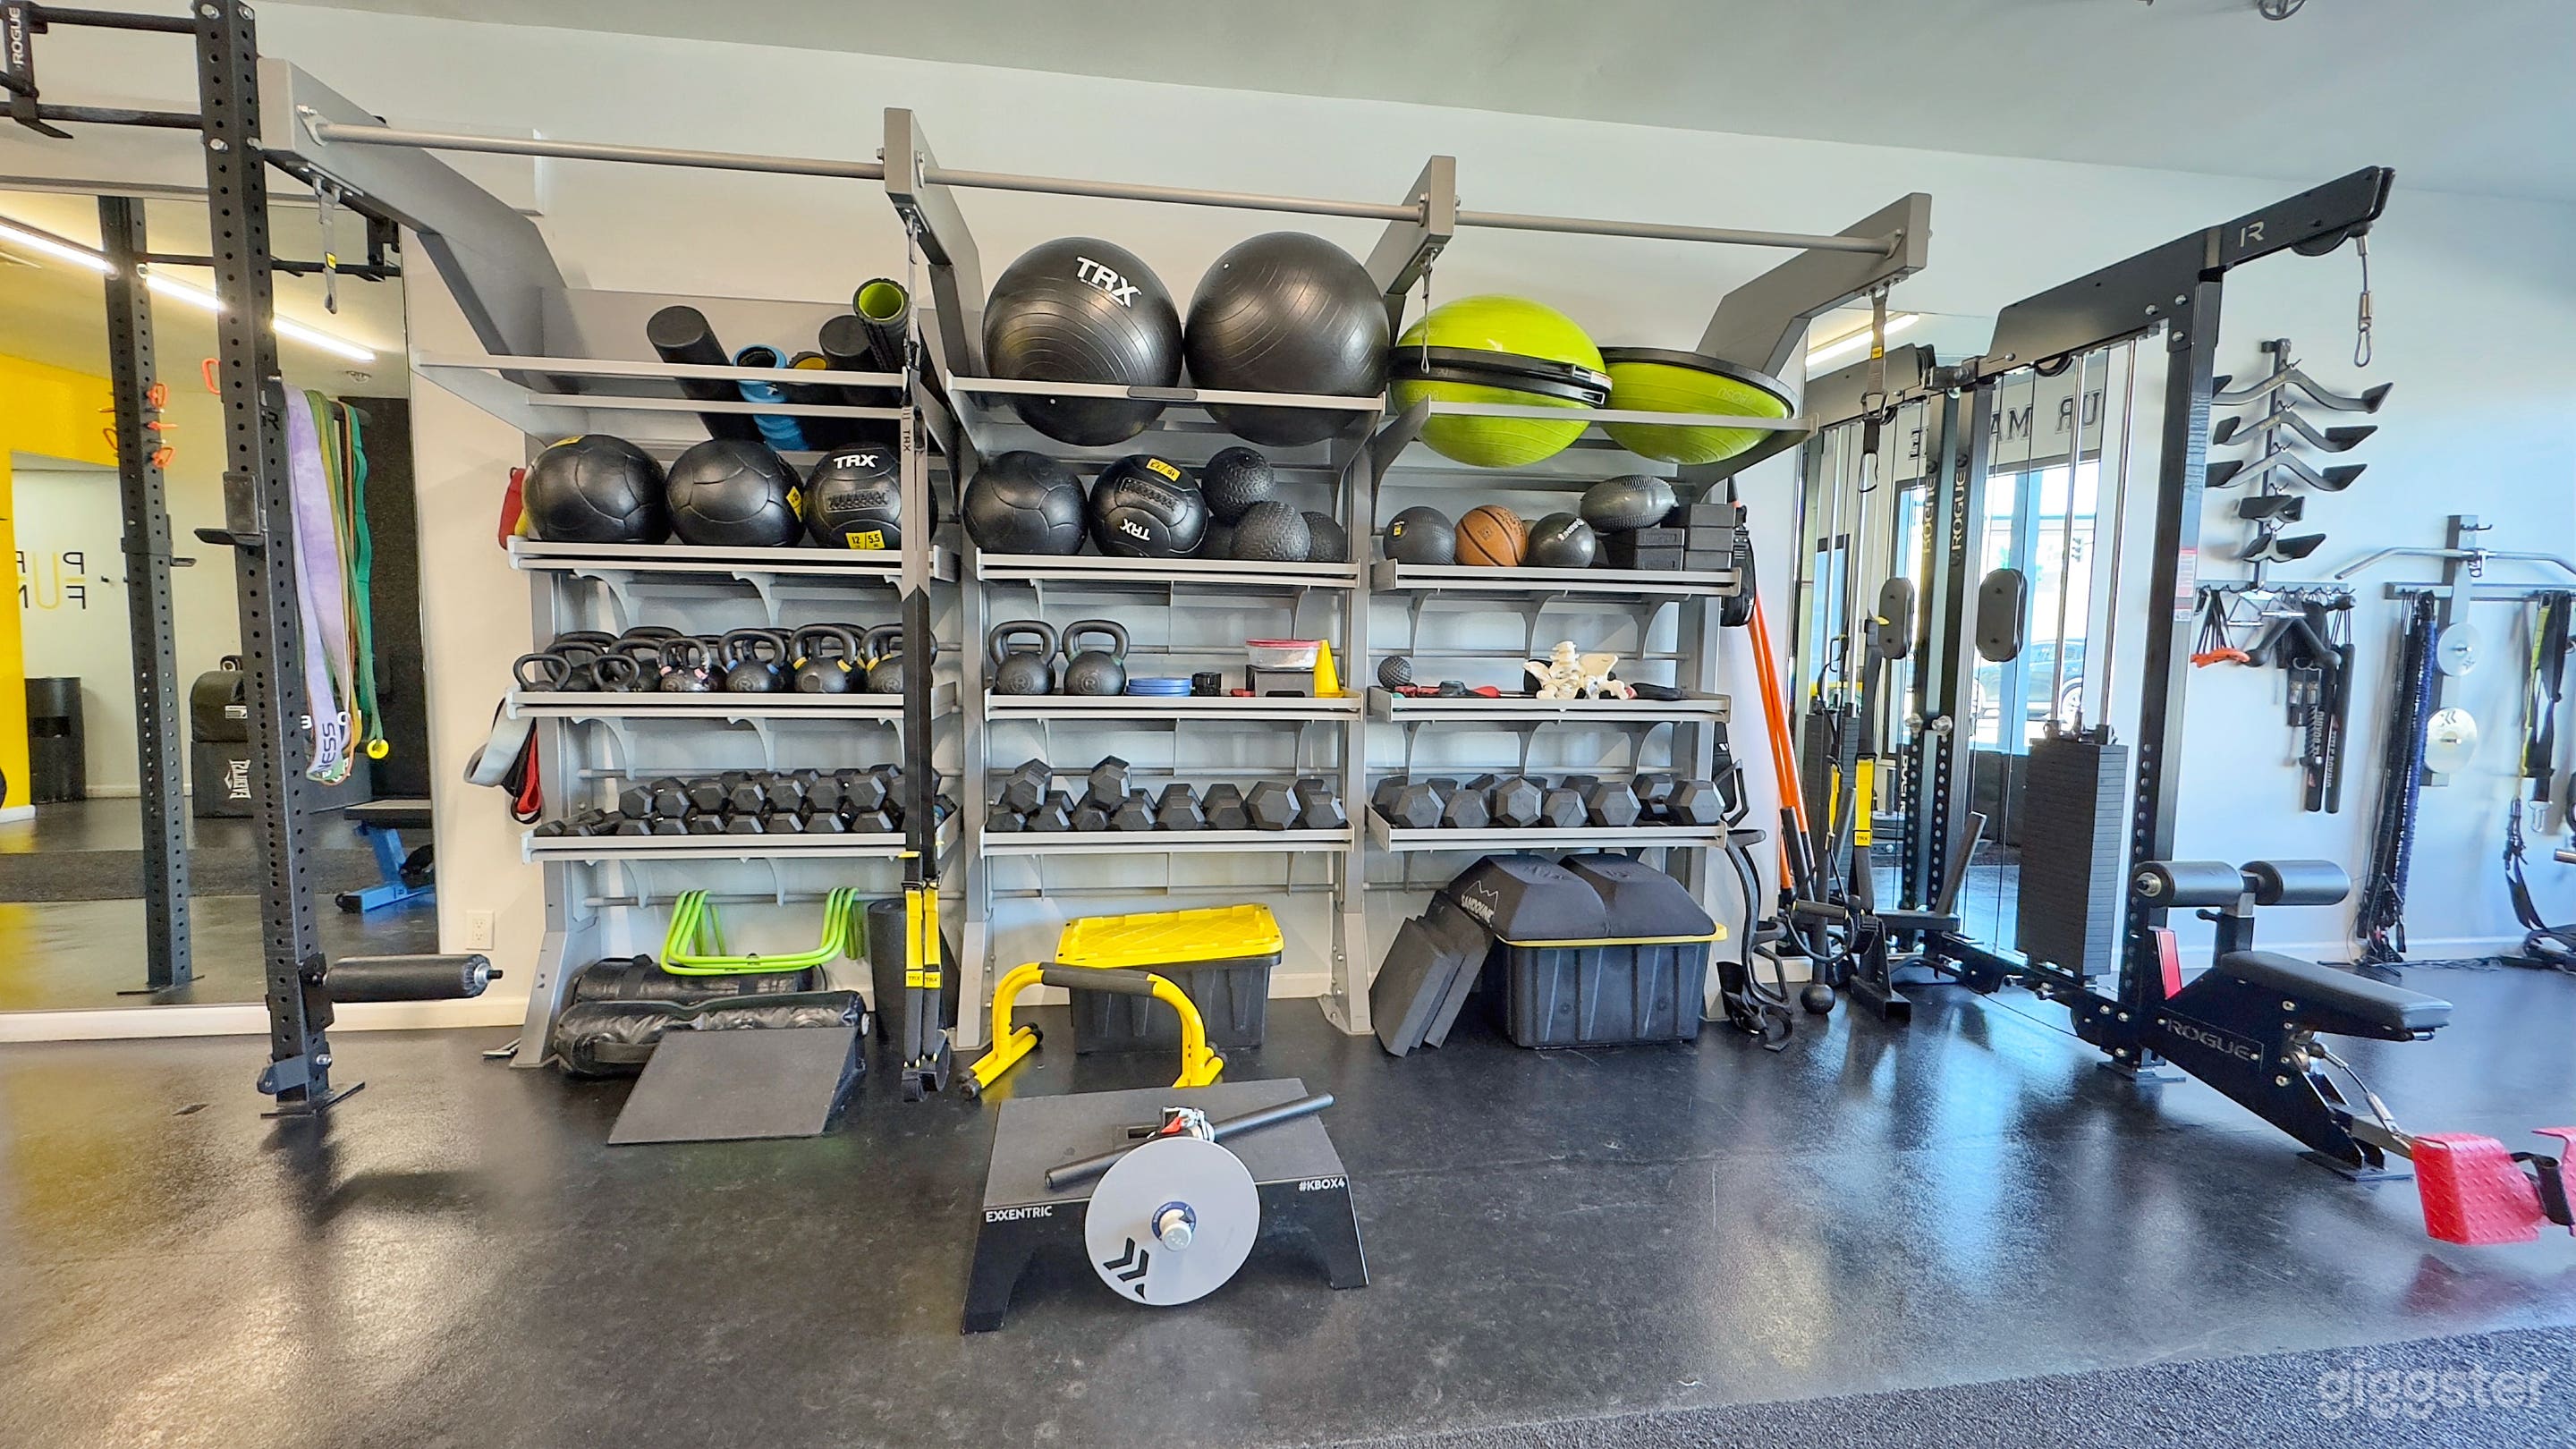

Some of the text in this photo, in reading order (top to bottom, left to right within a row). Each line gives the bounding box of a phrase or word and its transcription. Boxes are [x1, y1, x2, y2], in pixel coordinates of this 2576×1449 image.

[8, 7, 24, 65] ROGUE
[1077, 257, 1141, 308] TRX
[903, 429, 911, 452] TRX
[834, 454, 878, 470] TRX
[1953, 471, 1966, 551] ROGUE
[1120, 518, 1150, 541] TRX
[2167, 1019, 2250, 1061] ROGUE
[1299, 1177, 1345, 1191] #KBOX4
[986, 1205, 1053, 1223] EXXENTRIC
